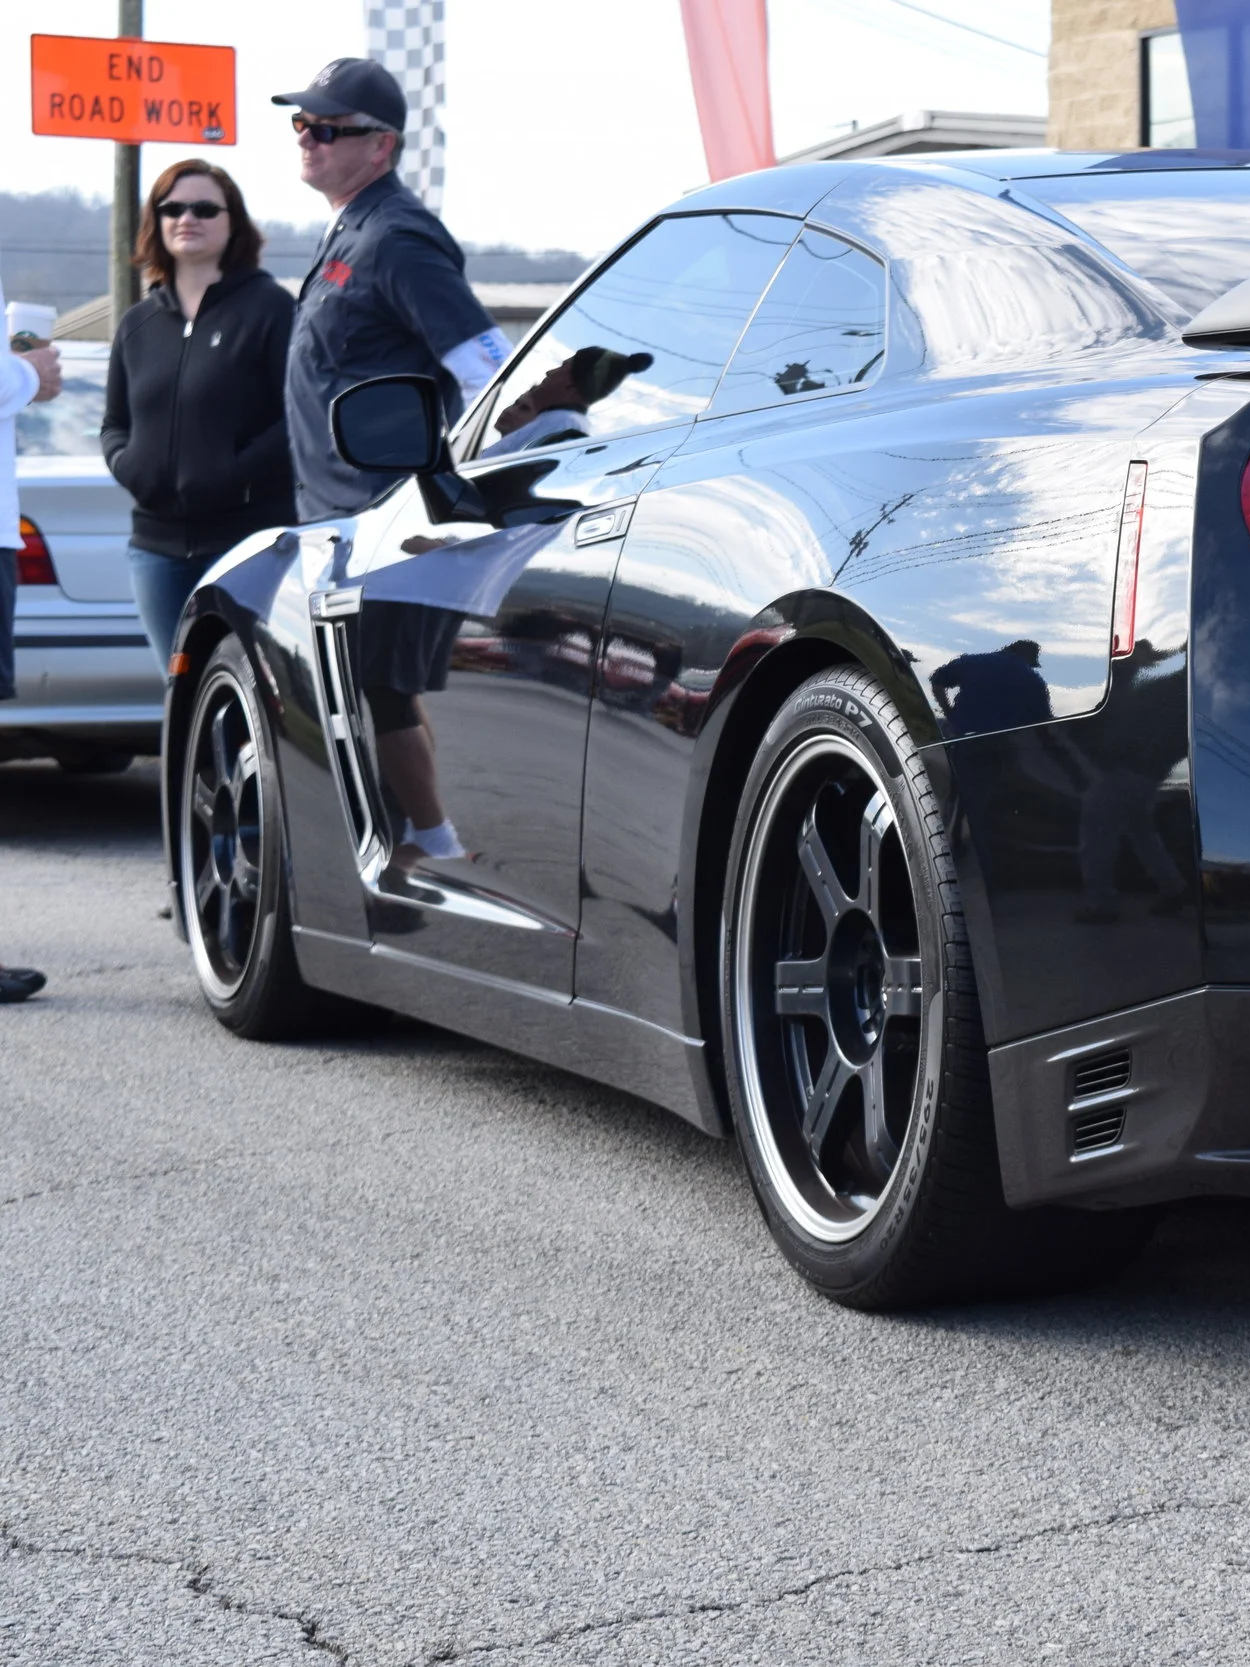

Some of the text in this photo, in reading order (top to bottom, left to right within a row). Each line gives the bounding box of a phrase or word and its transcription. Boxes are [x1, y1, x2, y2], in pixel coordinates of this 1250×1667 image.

[108, 53, 164, 82] END
[49, 92, 222, 128] ROAD WORK
[794, 693, 843, 715] Cinturato
[844, 700, 873, 728] P7
